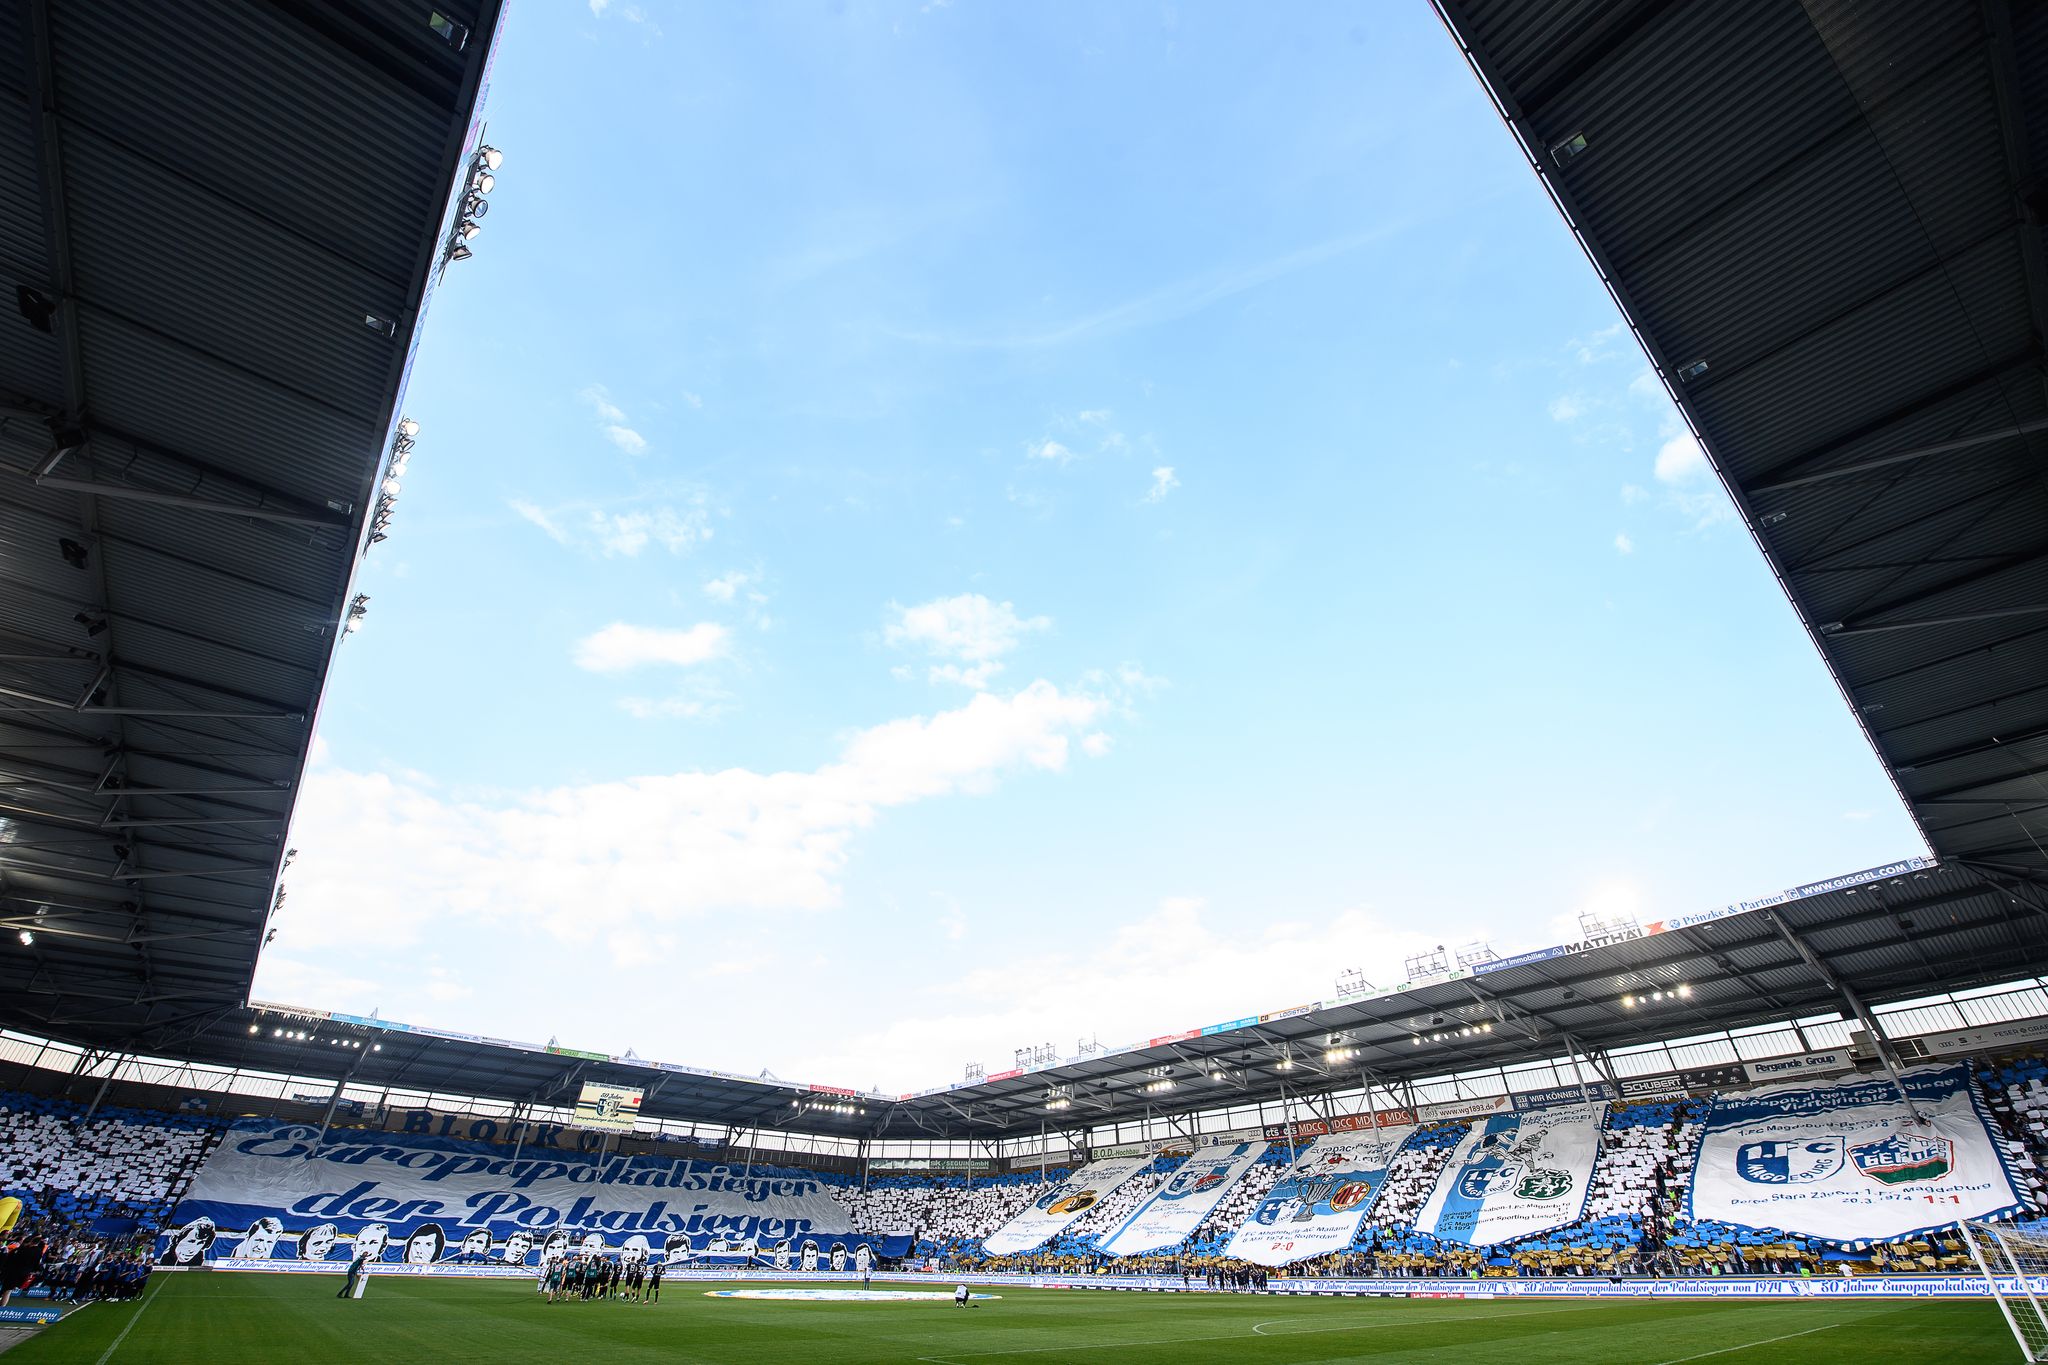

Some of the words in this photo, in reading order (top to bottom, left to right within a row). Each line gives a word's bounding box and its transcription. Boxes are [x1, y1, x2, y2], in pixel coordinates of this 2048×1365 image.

[1801, 864, 1907, 895] WWW.GIGGEL.COM
[1683, 909, 1724, 926] Prinzke
[1740, 894, 1785, 911] Partner
[1755, 1058, 1803, 1073] Pergande
[1806, 1054, 1836, 1067] Group
[1621, 1079, 1681, 1092] SCHUBERT
[1529, 1093, 1545, 1103] WIR
[1545, 1087, 1579, 1101] KÖNNEN
[1439, 1102, 1495, 1117] www.wg1893.de
[1299, 1122, 1324, 1134] MDCC
[1355, 1114, 1383, 1126] MDC
[405, 1111, 567, 1147] BLOCK
[1145, 1142, 1163, 1151] NMO
[238, 1125, 821, 1203] Europapokalsieger
[1747, 1158, 1833, 1183] MAGDEBURG
[293, 1181, 444, 1220] der
[465, 1190, 816, 1241] Pokalsieger
[1325, 1281, 1343, 1291] Jahre
[1345, 1281, 1404, 1293] Europapokalsieger
[1406, 1282, 1418, 1291] der
[1419, 1282, 1461, 1293] Pokalsieger
[1463, 1284, 1476, 1292] von
[1478, 1282, 1498, 1292] 1974
[1523, 1281, 1537, 1293] 50
[1539, 1282, 1565, 1293] Jahre
[1566, 1281, 1649, 1296] Europapokalsieger
[1652, 1281, 1668, 1293] der
[1670, 1281, 1730, 1296] Pokalsieger
[1732, 1284, 1751, 1293] von
[1755, 1281, 1783, 1293] 1974
[1821, 1279, 1839, 1292] 50
[1843, 1279, 1879, 1293] Jahre
[1883, 1279, 2005, 1296] Europapokalsiegr
[27, 1309, 58, 1318] mhkw
